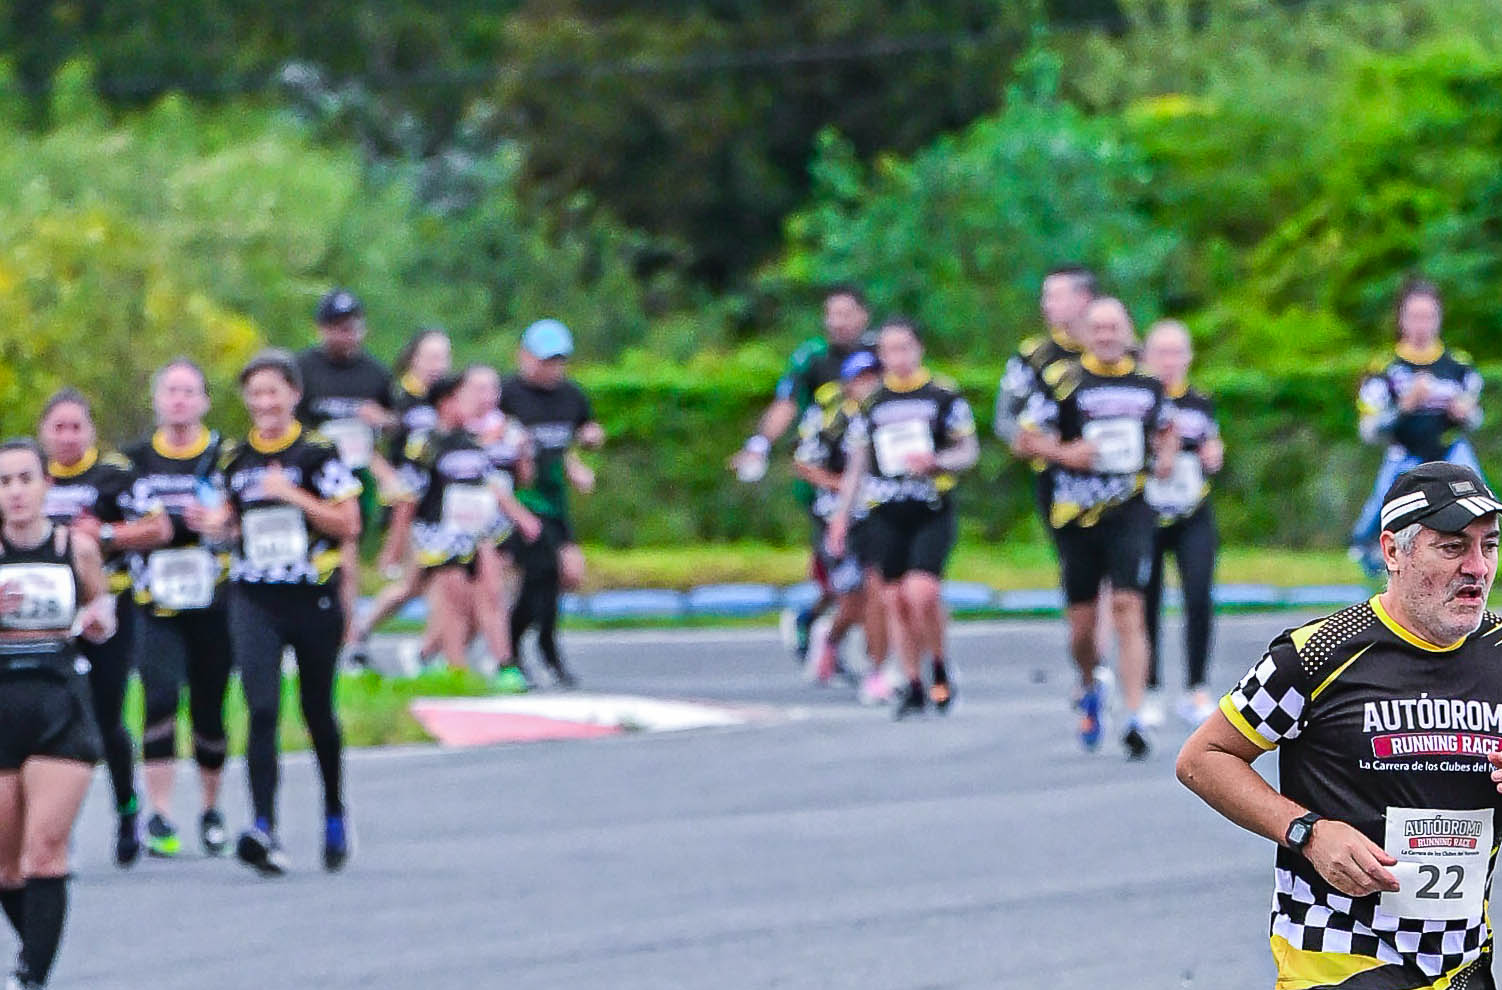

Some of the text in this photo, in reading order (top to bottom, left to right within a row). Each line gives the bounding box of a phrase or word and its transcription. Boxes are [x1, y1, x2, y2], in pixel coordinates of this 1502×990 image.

[1391, 735, 1500, 755] RUNNING RACE
[1359, 760, 1371, 769] La
[1373, 761, 1410, 770] Carrera
[1411, 761, 1423, 770] de
[1425, 761, 1438, 771] los
[1440, 761, 1471, 772] Clubes
[1473, 762, 1487, 772] del
[1403, 815, 1482, 837] AUTÓDROMO
[1417, 838, 1471, 847] RUNNING RACE
[1416, 865, 1464, 899] 22
